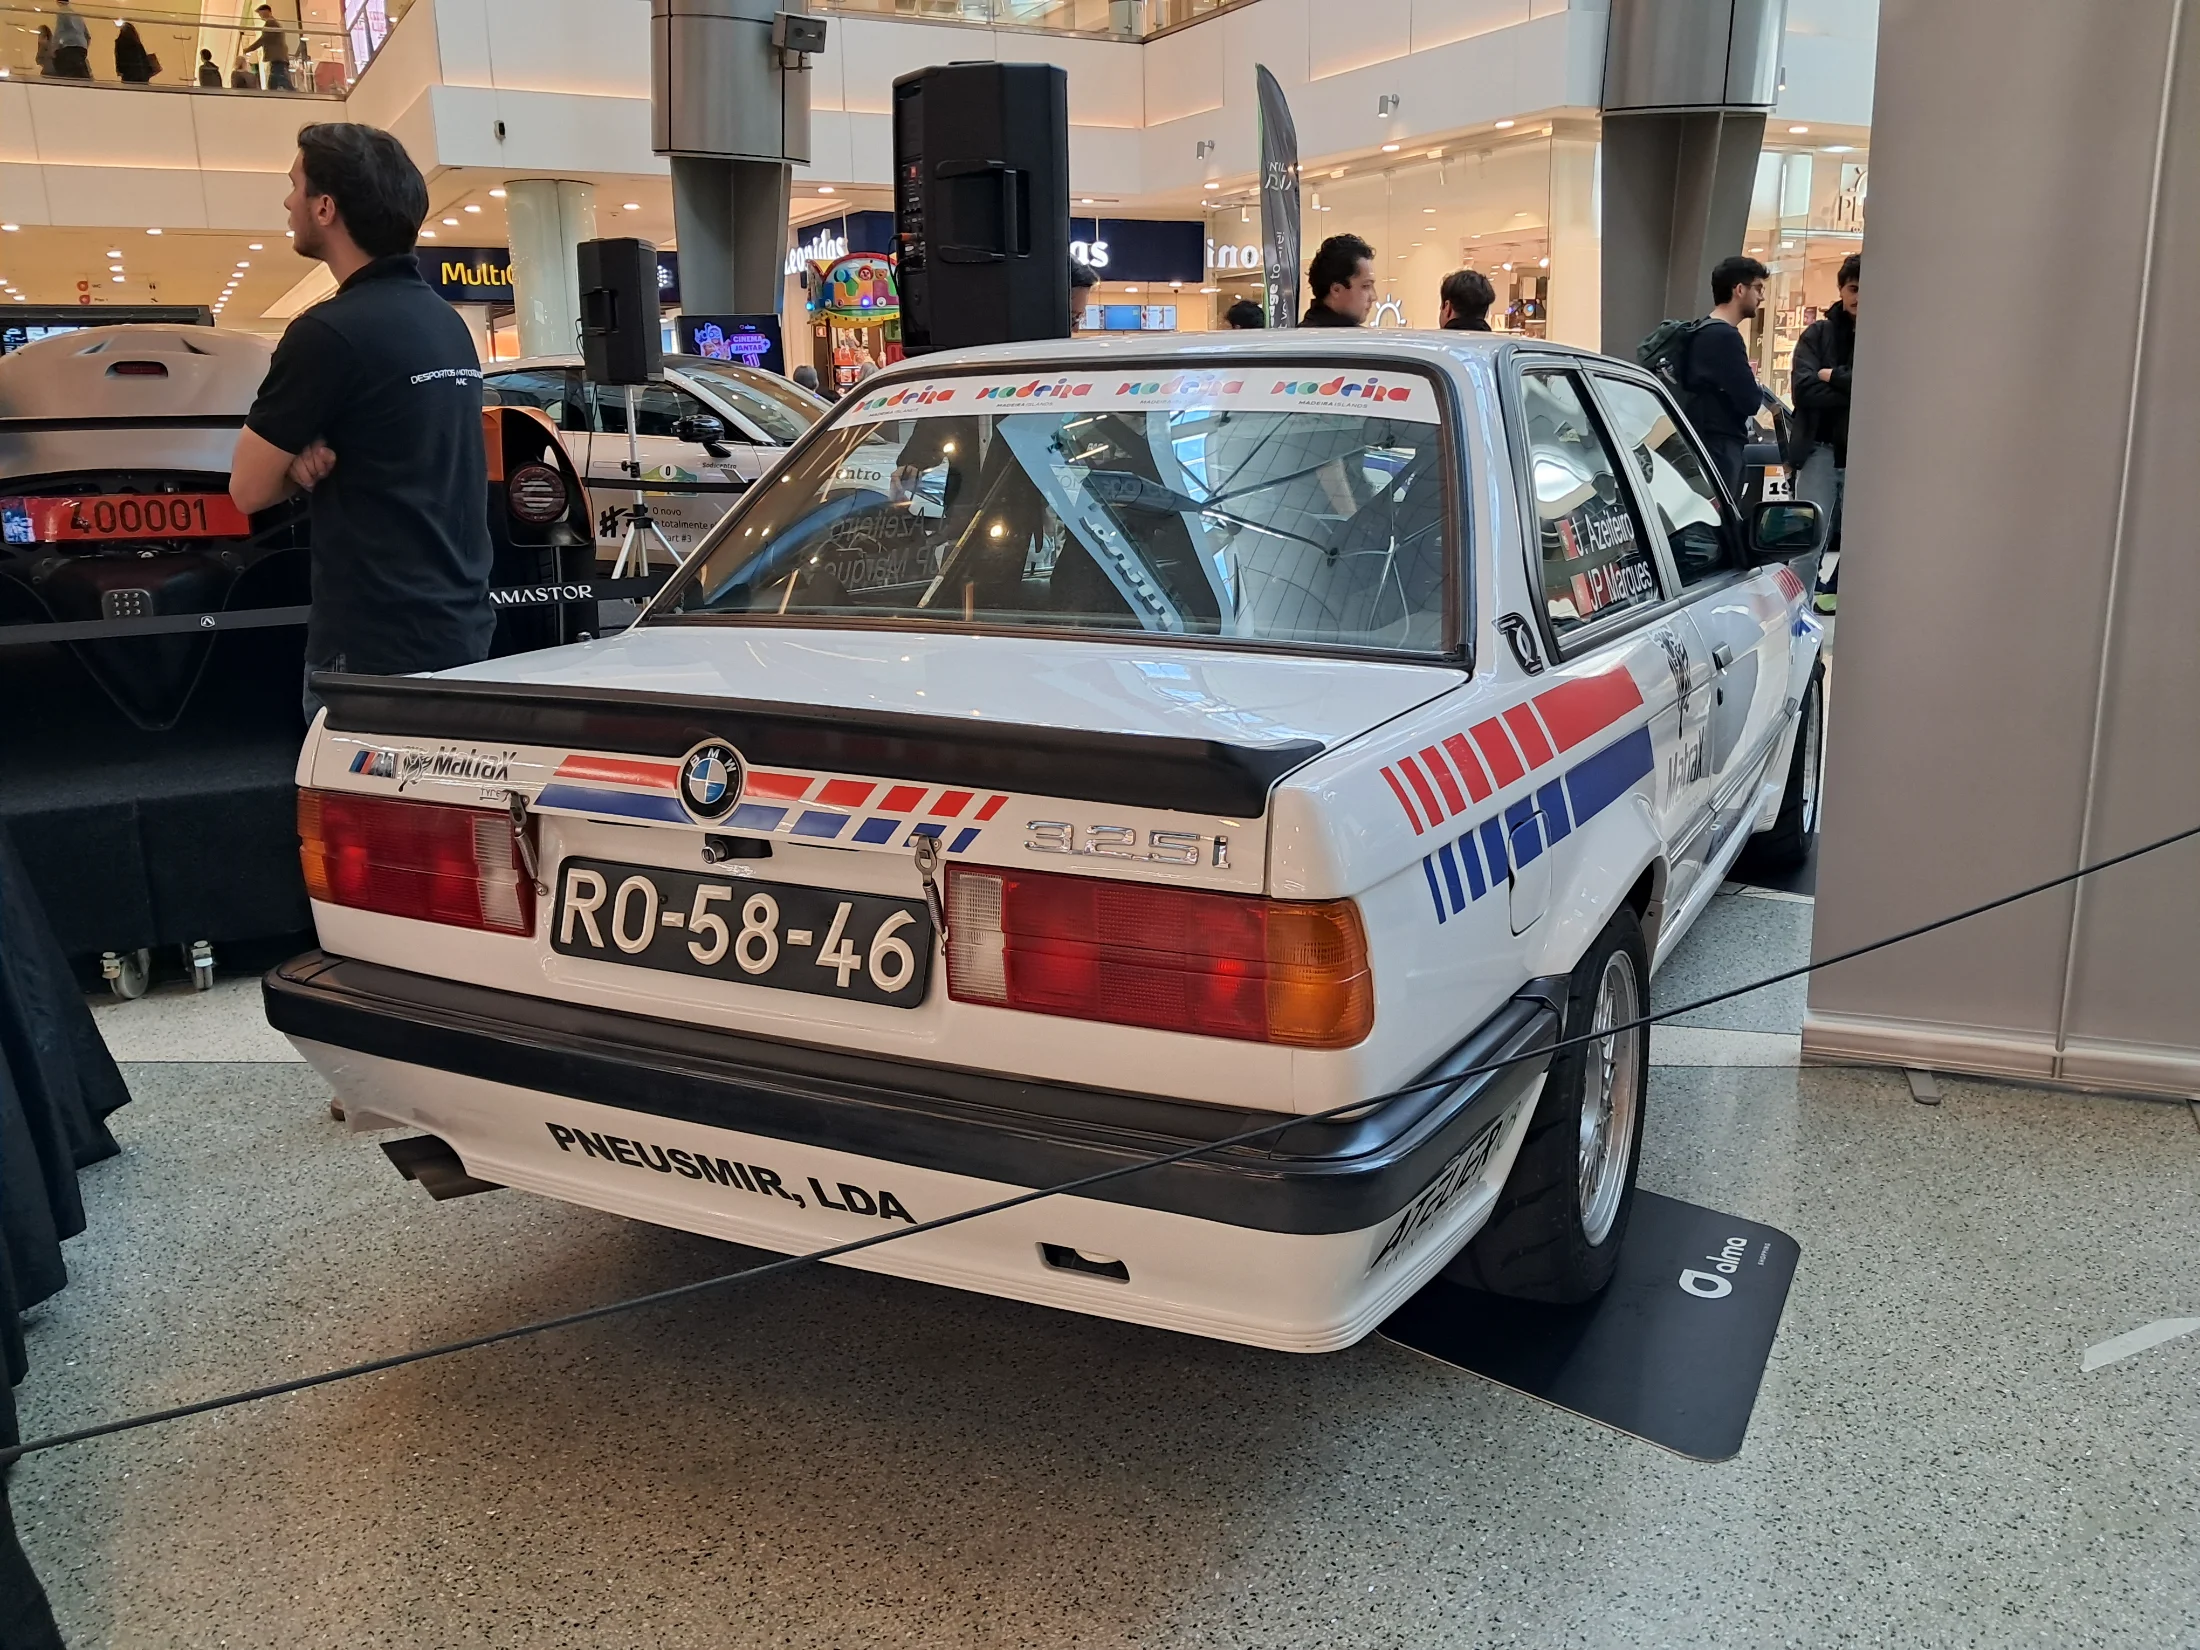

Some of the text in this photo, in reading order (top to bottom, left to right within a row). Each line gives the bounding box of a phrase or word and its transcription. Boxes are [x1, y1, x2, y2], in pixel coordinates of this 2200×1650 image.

[785, 228, 848, 275] Leonidas
[733, 335, 762, 343] CINEMA
[735, 344, 763, 352] JANTAR
[410, 368, 455, 385] DESPORTOS
[665, 466, 671, 476] 0
[836, 466, 881, 481] entro
[70, 498, 207, 533] 400001
[661, 508, 682, 516] novo
[661, 521, 708, 529] totalmente
[682, 534, 692, 543] #3
[1570, 506, 1635, 557] J. Azeiteiro
[489, 585, 594, 604] AMASTOR
[1587, 560, 1653, 612] JP Marques
[432, 746, 517, 782] MatraX
[689, 747, 737, 773] BMW
[1024, 820, 1231, 869] 325i
[559, 868, 917, 993] RO-58-46
[545, 1122, 918, 1224] PNEUSMIR, LDA
[1705, 1237, 1748, 1274] alma
